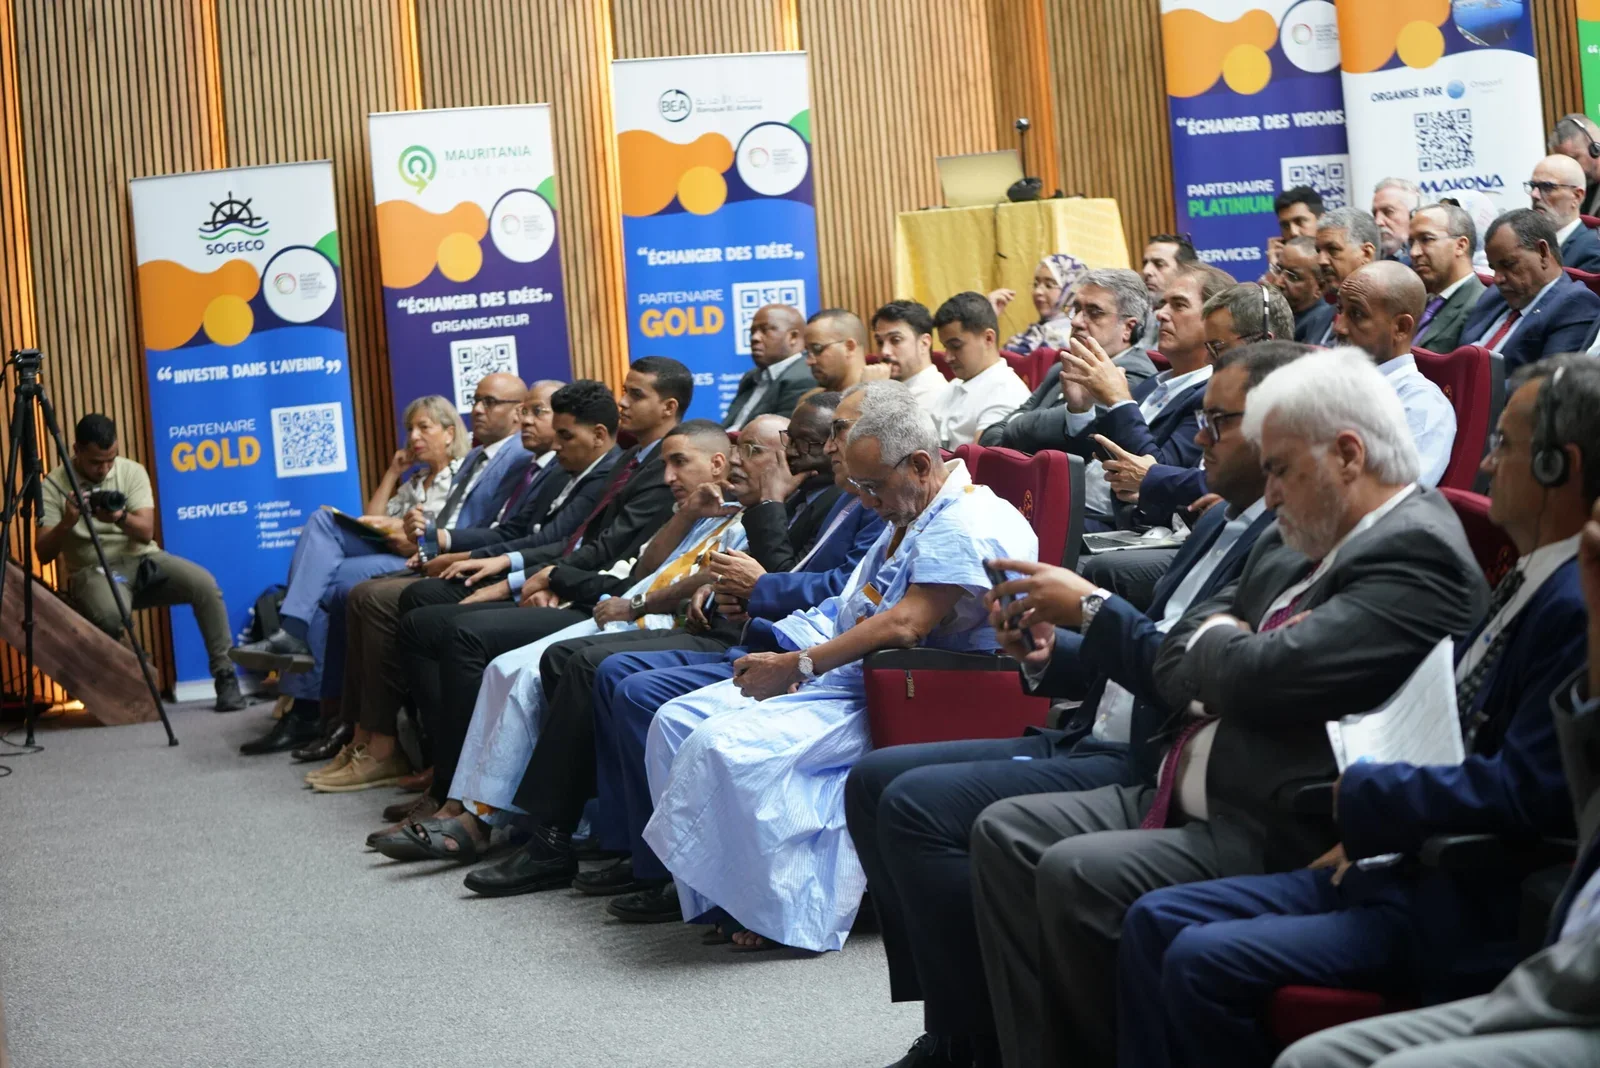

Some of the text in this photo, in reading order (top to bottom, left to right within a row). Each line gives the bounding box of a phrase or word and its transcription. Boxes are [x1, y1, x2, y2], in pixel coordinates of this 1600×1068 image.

[1423, 86, 1444, 97] PAR
[661, 100, 689, 113] BEA
[1263, 113, 1290, 130] DES
[445, 145, 533, 161] MAURITANIA
[1186, 179, 1275, 197] PARTENAIRE
[1420, 174, 1505, 195] MAKONA
[1187, 194, 1275, 218] PLATINIUM
[206, 239, 265, 255] SOGECO
[725, 246, 752, 262] DES
[480, 291, 506, 308] DES
[638, 289, 724, 305] PARTENAIRE
[431, 313, 530, 334] ORGANISATEUR
[639, 305, 725, 338] GOLD
[232, 362, 268, 378] DANS
[169, 418, 257, 439] PARTENAIRE
[171, 436, 262, 473] GOLD
[177, 501, 249, 520] SERVICES
